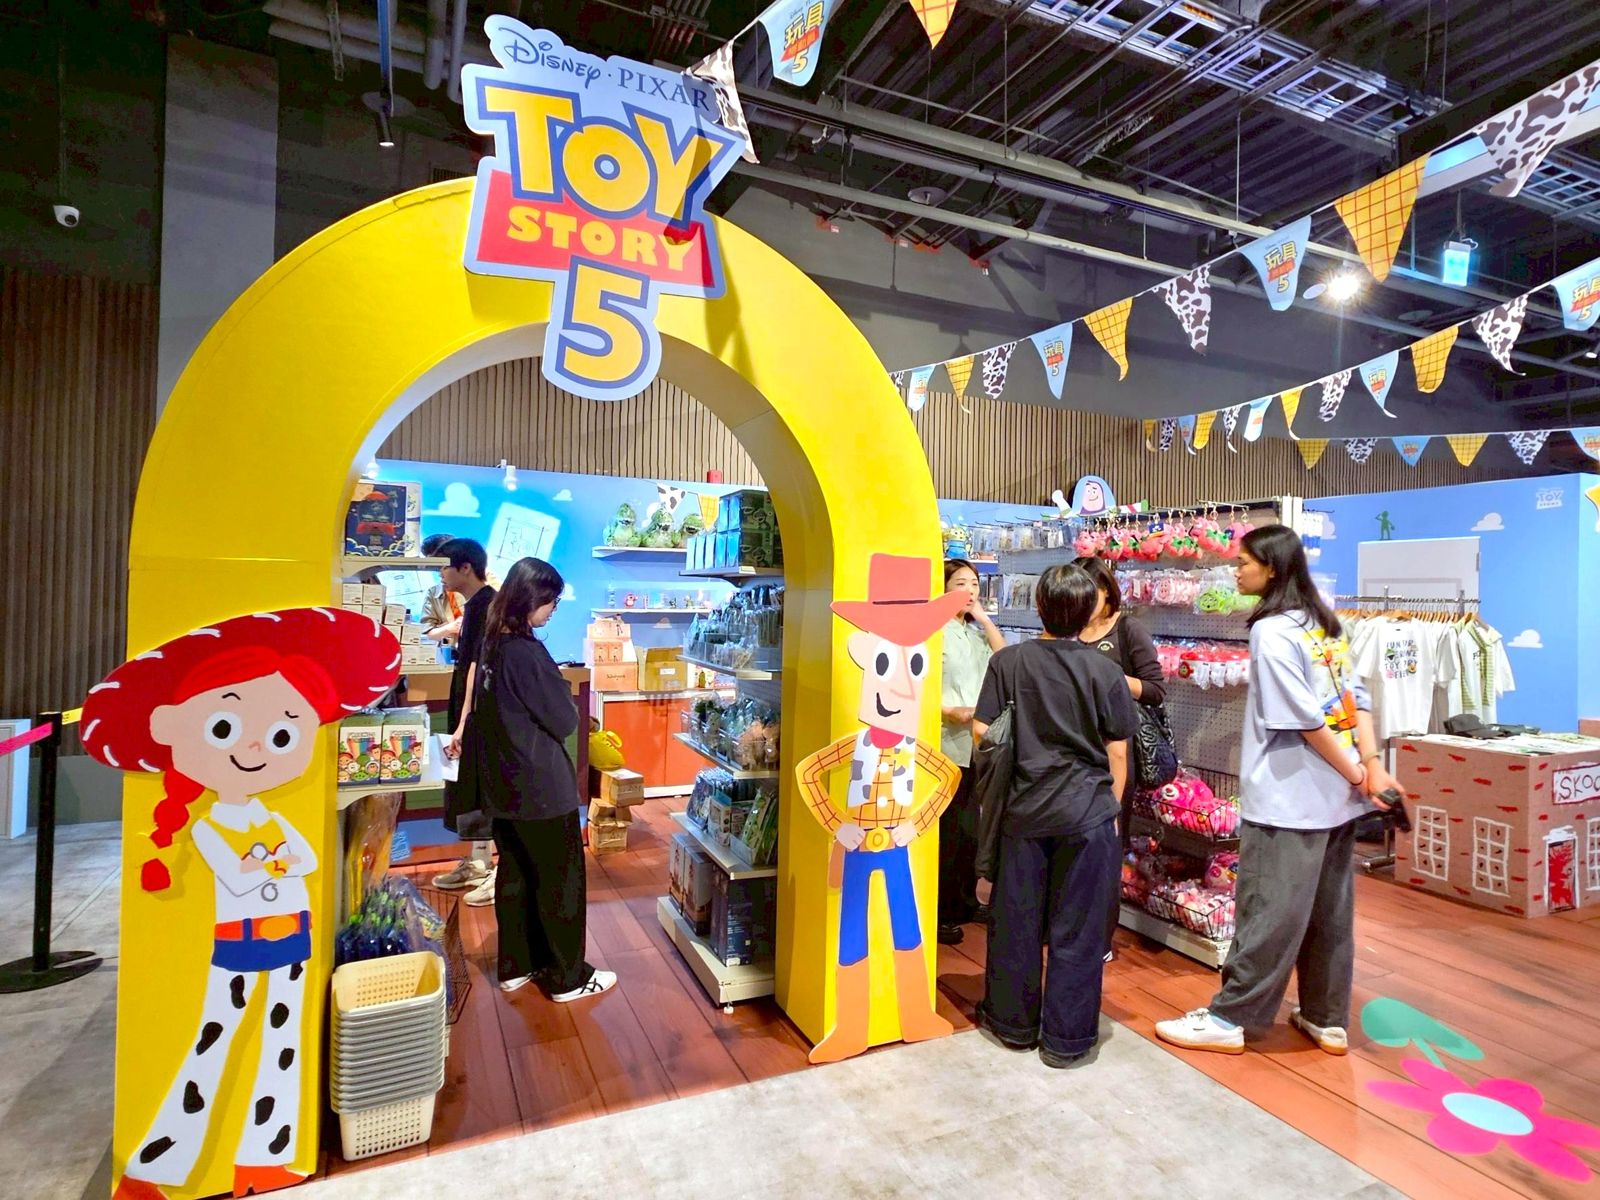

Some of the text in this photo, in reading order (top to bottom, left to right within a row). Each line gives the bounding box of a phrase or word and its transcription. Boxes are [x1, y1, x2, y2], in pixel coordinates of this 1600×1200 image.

[783, 0, 824, 50] 玩具
[791, 48, 809, 74] 5
[617, 67, 710, 111] PIXAR
[483, 84, 725, 221] TOY
[506, 205, 695, 272] STORY
[1264, 241, 1297, 271] 玩具
[1276, 273, 1290, 294] 5
[561, 262, 645, 382] 5
